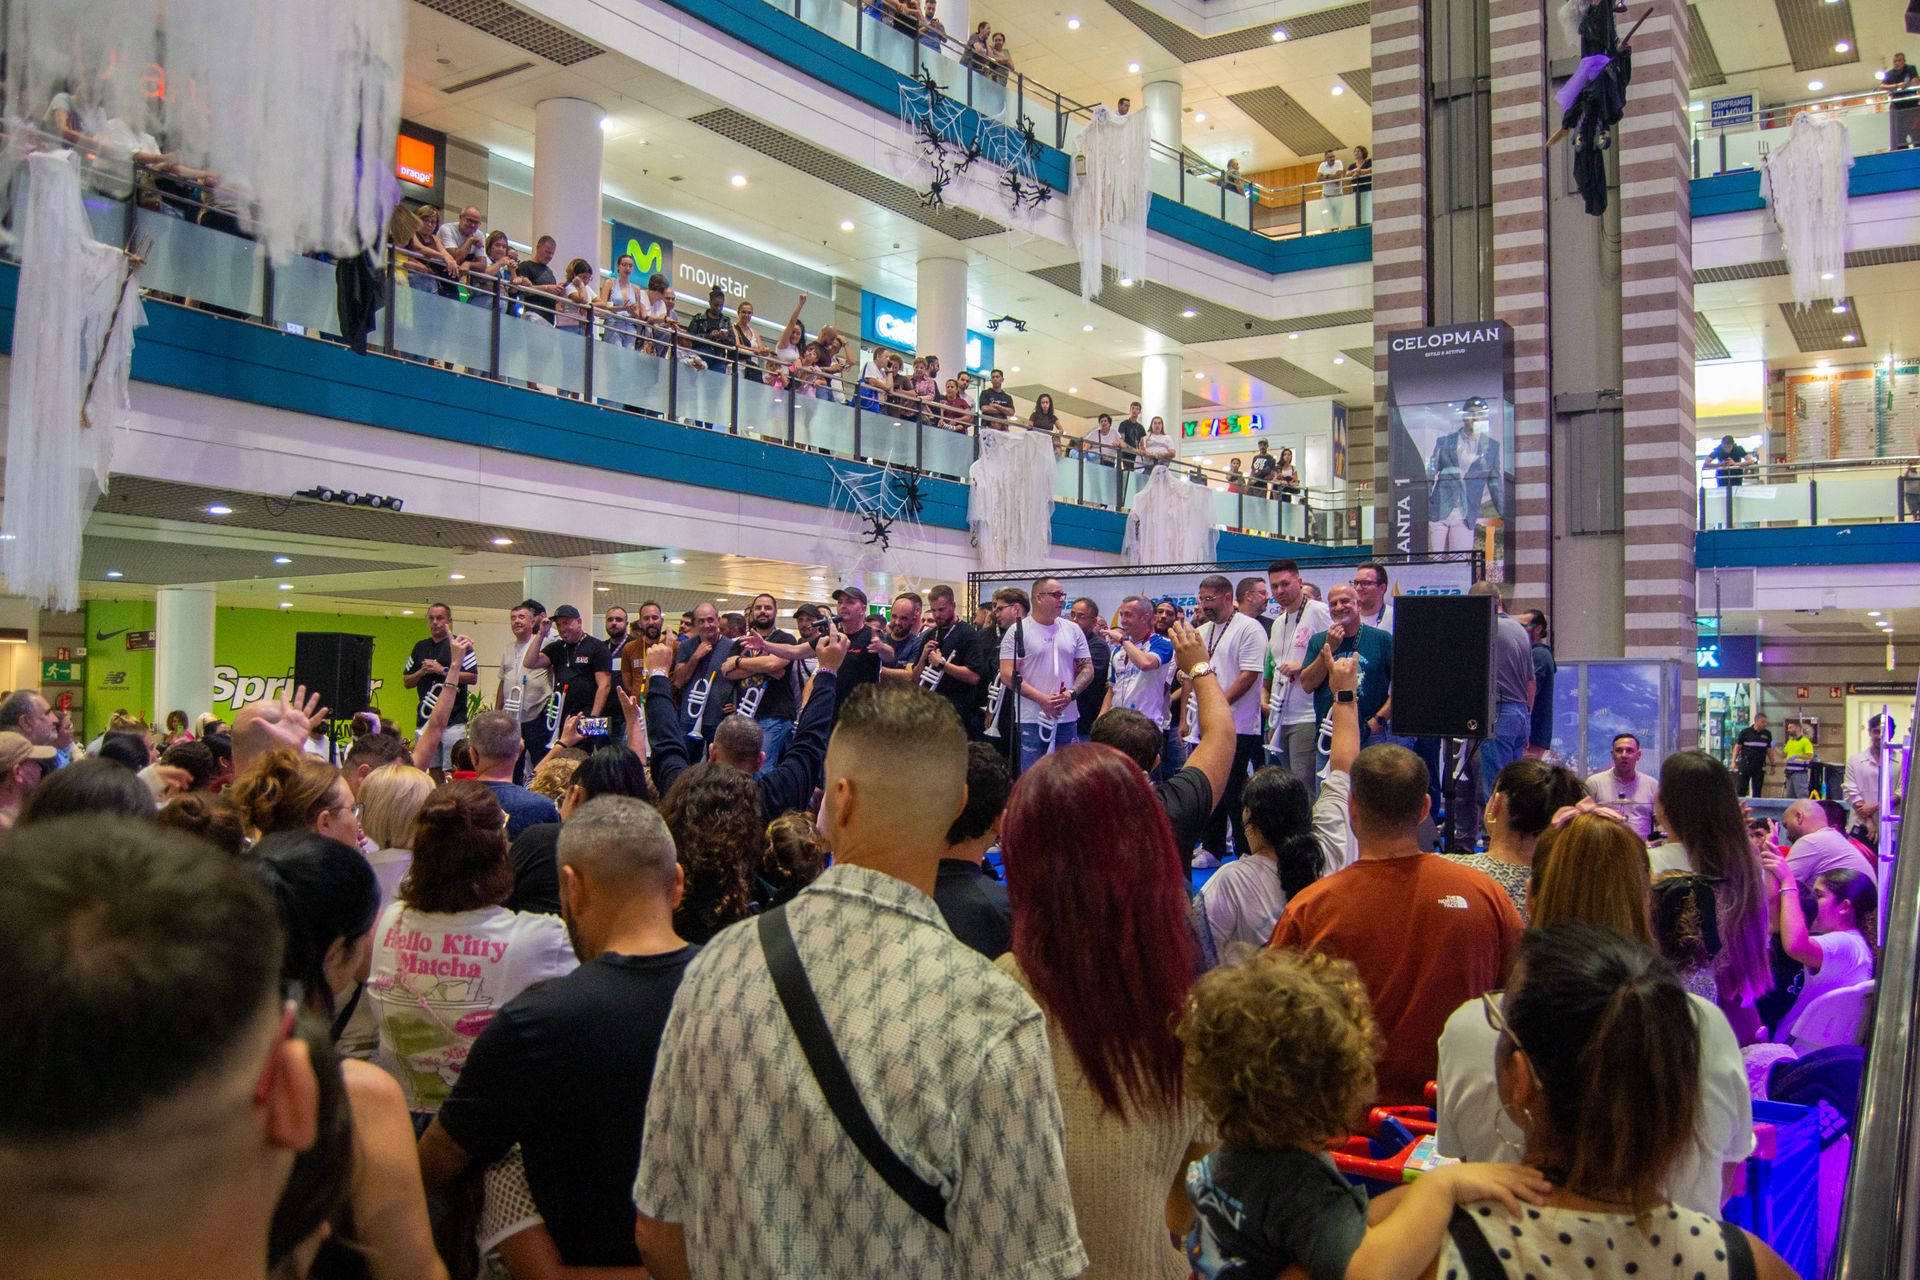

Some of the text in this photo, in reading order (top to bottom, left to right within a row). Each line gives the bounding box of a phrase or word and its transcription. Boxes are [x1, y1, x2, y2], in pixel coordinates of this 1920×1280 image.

[400, 165, 430, 182] orange
[679, 263, 749, 299] movistar
[1392, 327, 1500, 351] CELOPMAN
[1200, 414, 1264, 438] FIESTA
[1397, 495, 1411, 564] LANTA
[383, 927, 509, 964] Hello Kitty
[400, 951, 482, 979] Matcha
